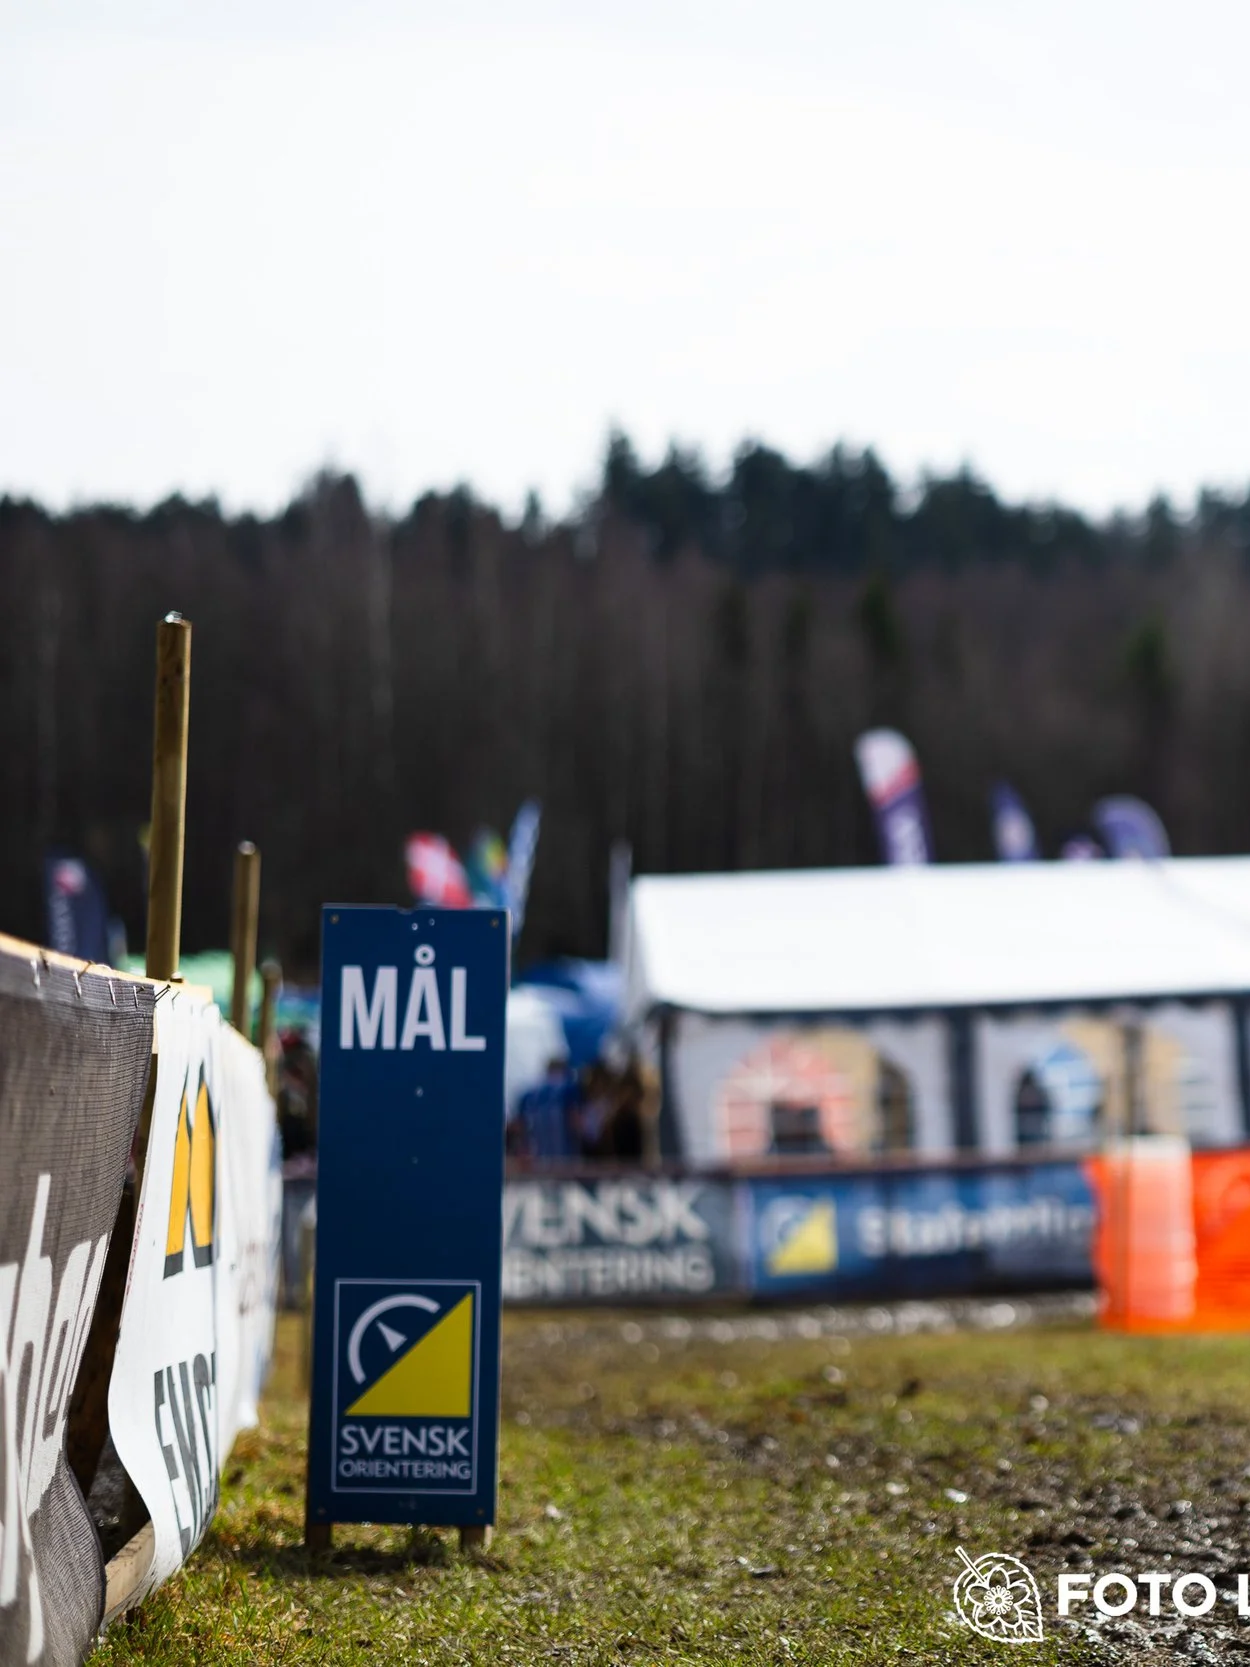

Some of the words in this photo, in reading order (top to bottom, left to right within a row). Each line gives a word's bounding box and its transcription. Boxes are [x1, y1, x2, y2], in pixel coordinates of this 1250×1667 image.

[340, 944, 487, 1051] MÅL
[341, 1424, 469, 1456] SVENSK
[338, 1458, 471, 1480] ORIENTERING
